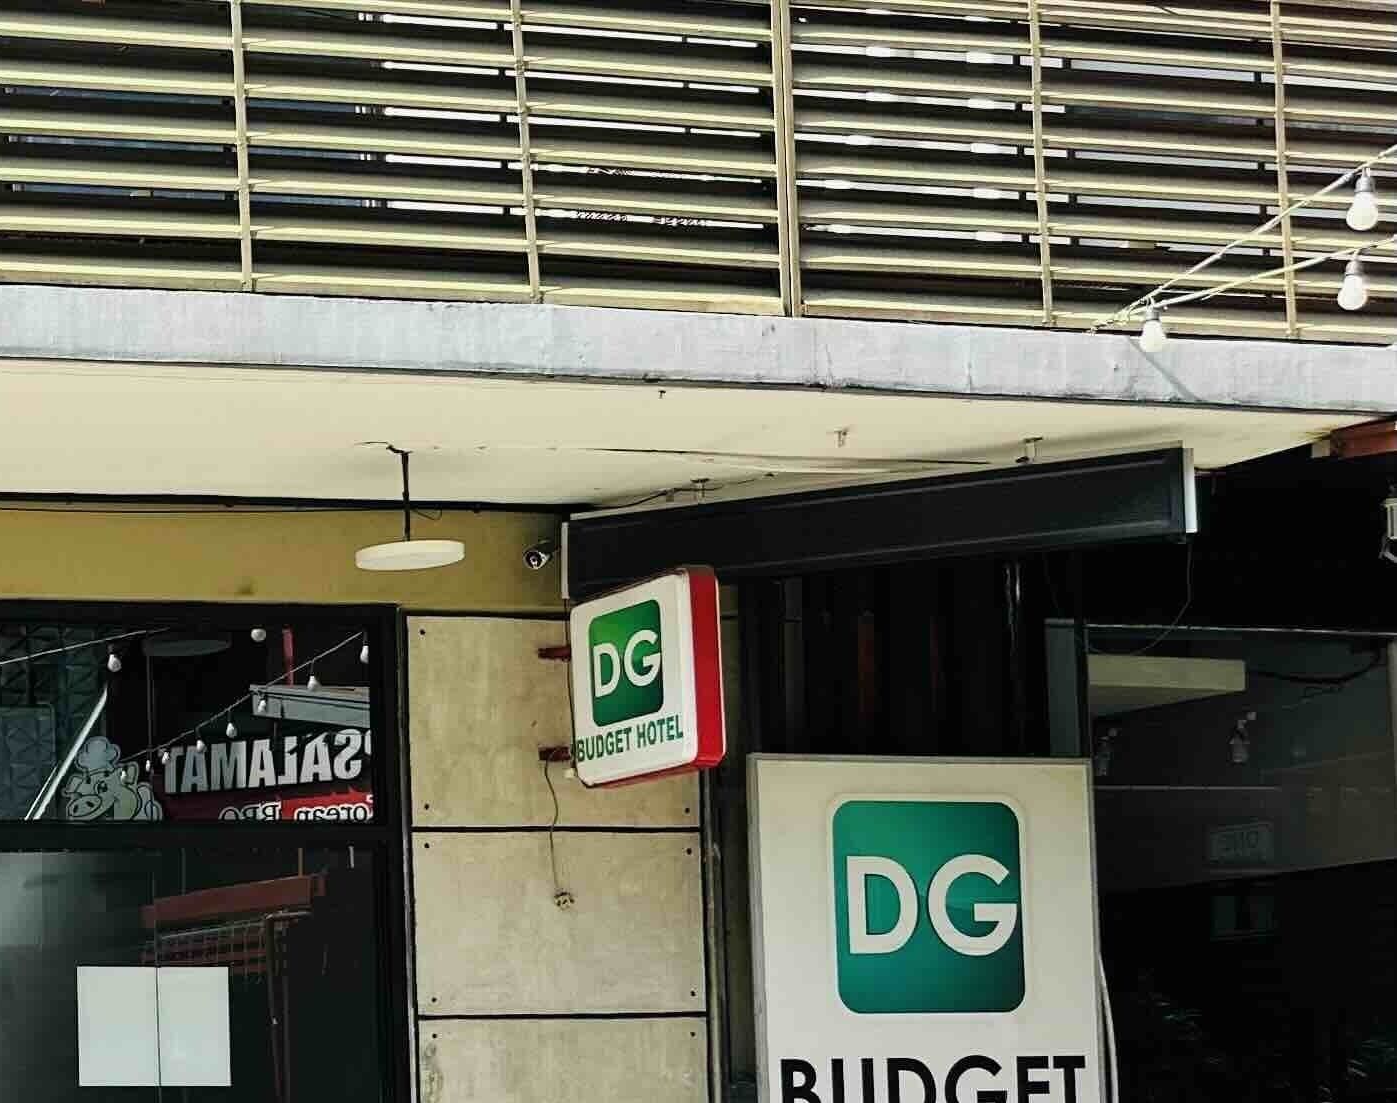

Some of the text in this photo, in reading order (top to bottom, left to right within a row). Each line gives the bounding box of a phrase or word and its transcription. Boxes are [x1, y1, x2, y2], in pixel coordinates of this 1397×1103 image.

[593, 630, 661, 697] DG
[576, 714, 683, 762] BUDGET HOTEL
[846, 854, 1018, 956] DG
